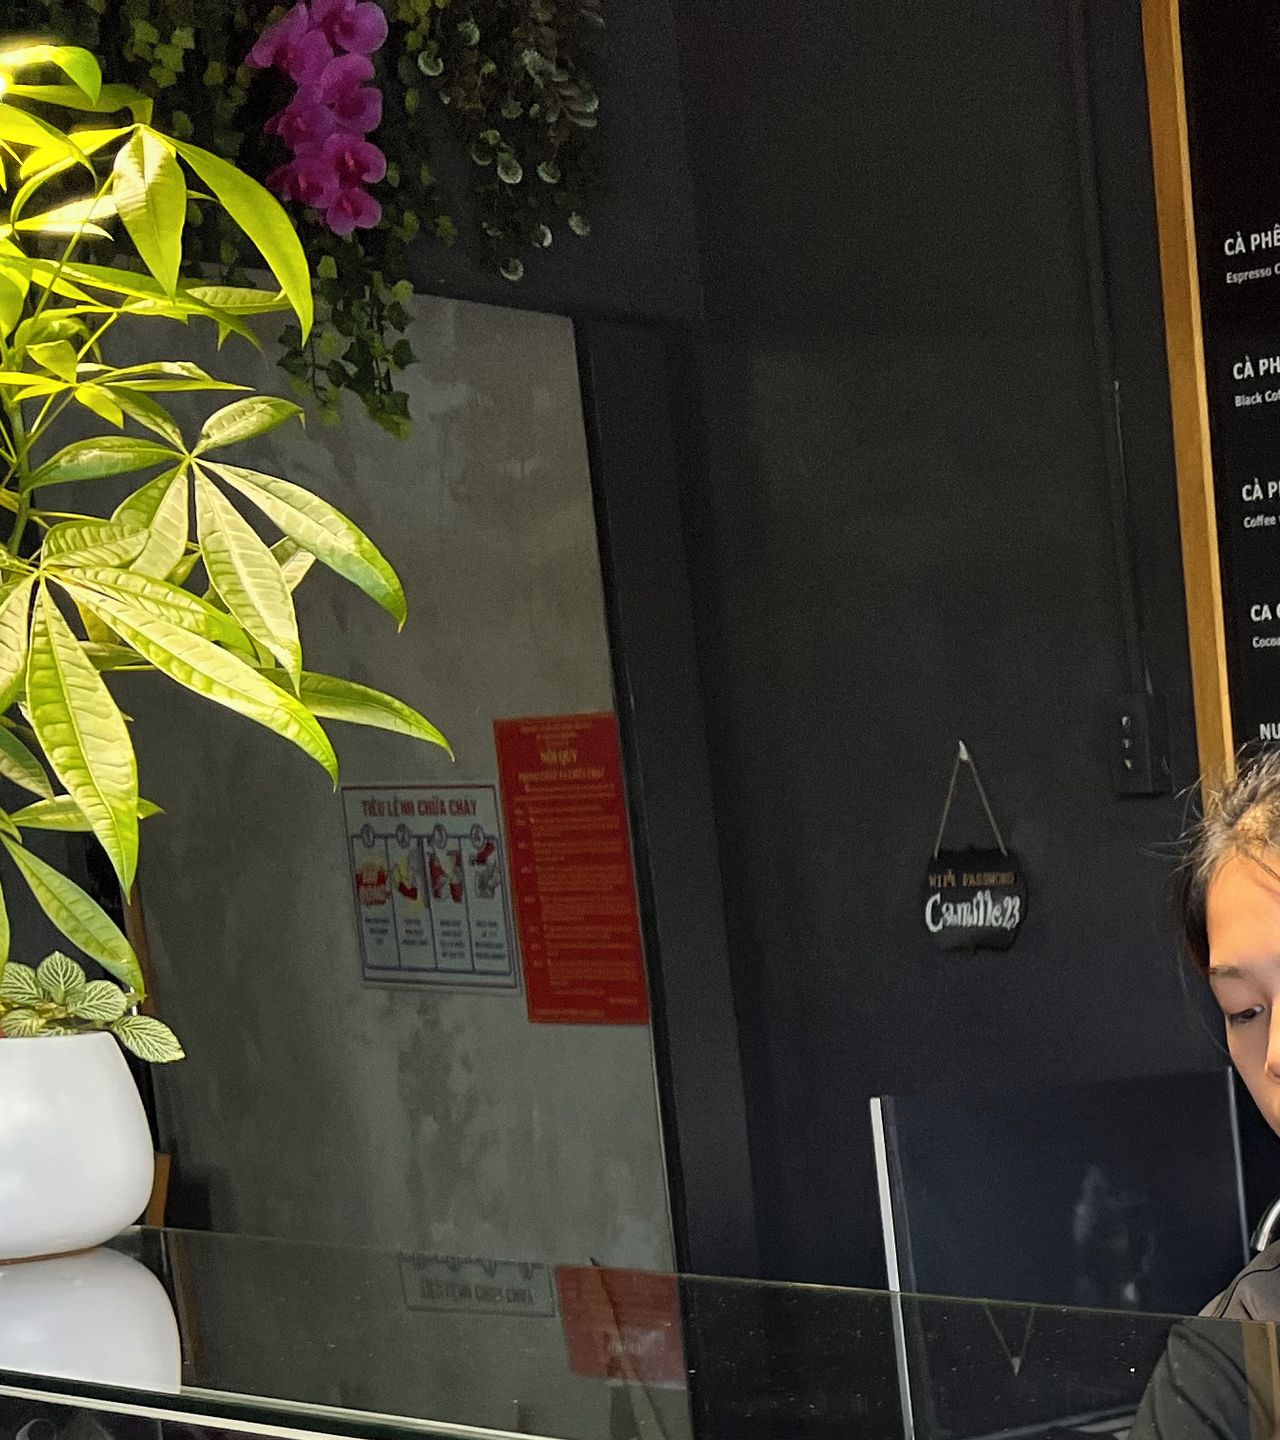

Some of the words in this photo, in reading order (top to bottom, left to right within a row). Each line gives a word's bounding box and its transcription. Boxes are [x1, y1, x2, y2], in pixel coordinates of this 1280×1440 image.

[1225, 231, 1246, 255] CÀ
[1226, 268, 1272, 284] Espresso
[1233, 356, 1254, 379] CÀ
[1235, 392, 1262, 407] Black
[1242, 478, 1263, 501] CÀ
[1244, 515, 1276, 528] Coffee
[1251, 605, 1272, 621] CA
